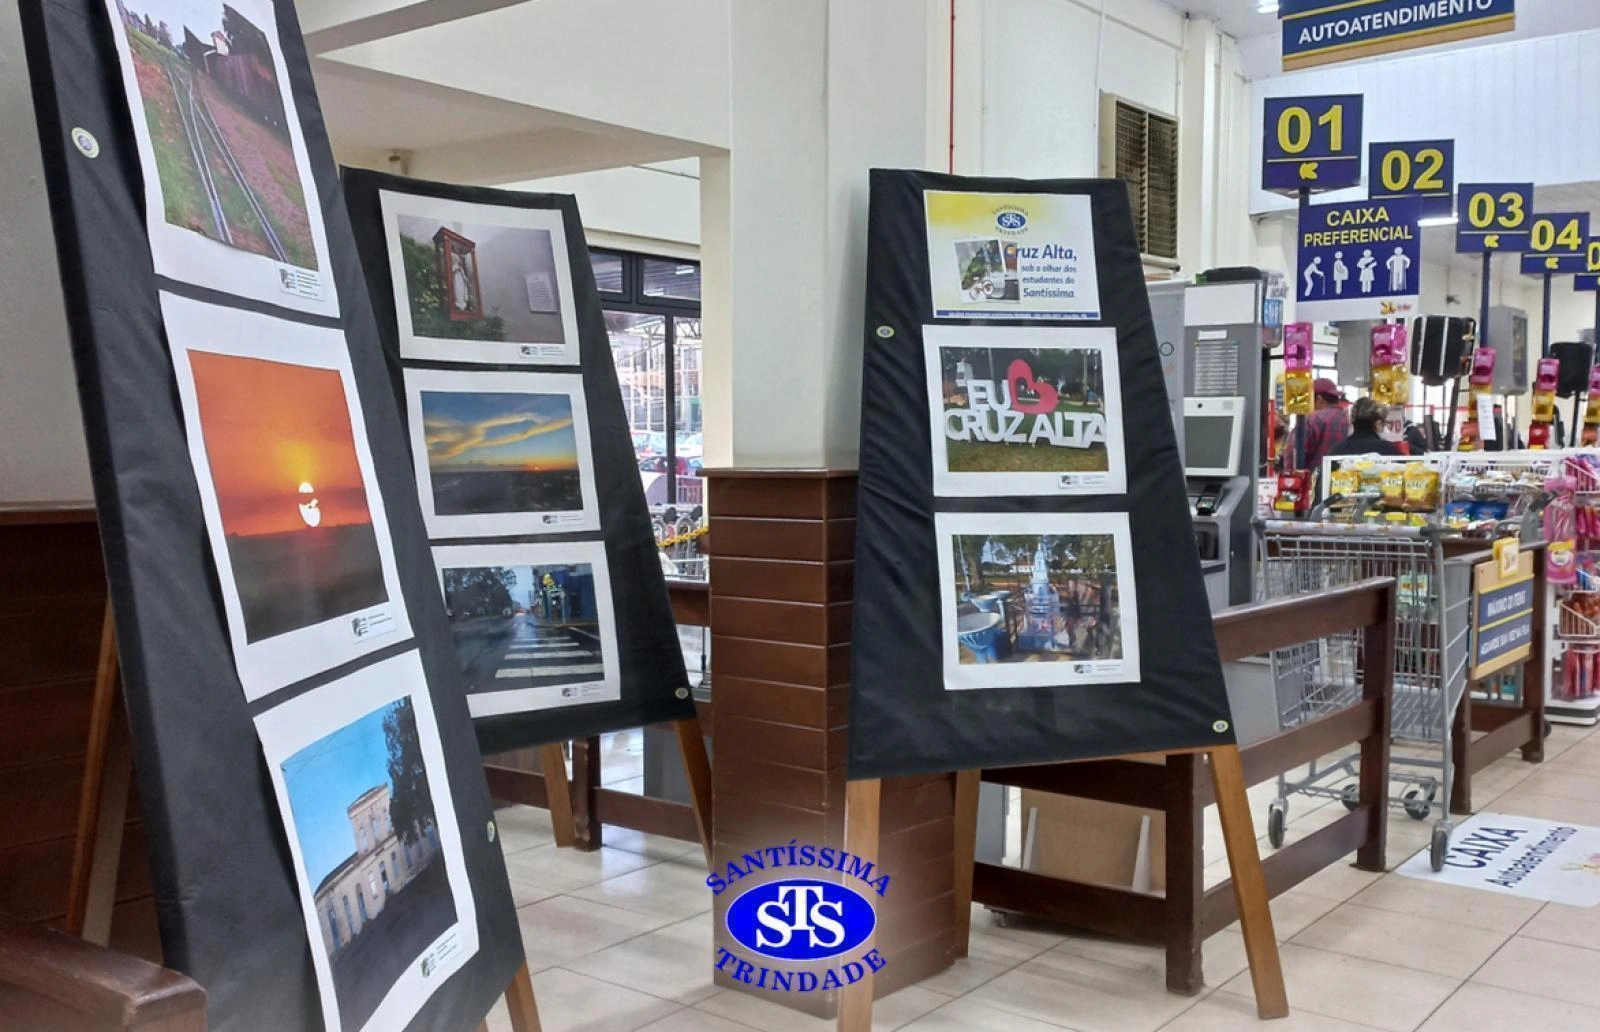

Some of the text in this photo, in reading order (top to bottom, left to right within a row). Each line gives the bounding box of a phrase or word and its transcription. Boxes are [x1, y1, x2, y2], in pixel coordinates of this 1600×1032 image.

[1277, 104, 1345, 154] 01
[1381, 149, 1445, 191] 02
[1326, 206, 1390, 227] CAIXA
[1468, 192, 1525, 228] 03
[1004, 243, 1077, 262] Cruz Alta,
[1303, 225, 1413, 248] PREFERENCIAL
[1530, 219, 1582, 252] 04
[967, 379, 1011, 411] EU
[945, 408, 1107, 449] CRUZ ALTA
[1444, 827, 1528, 868] CAIXA
